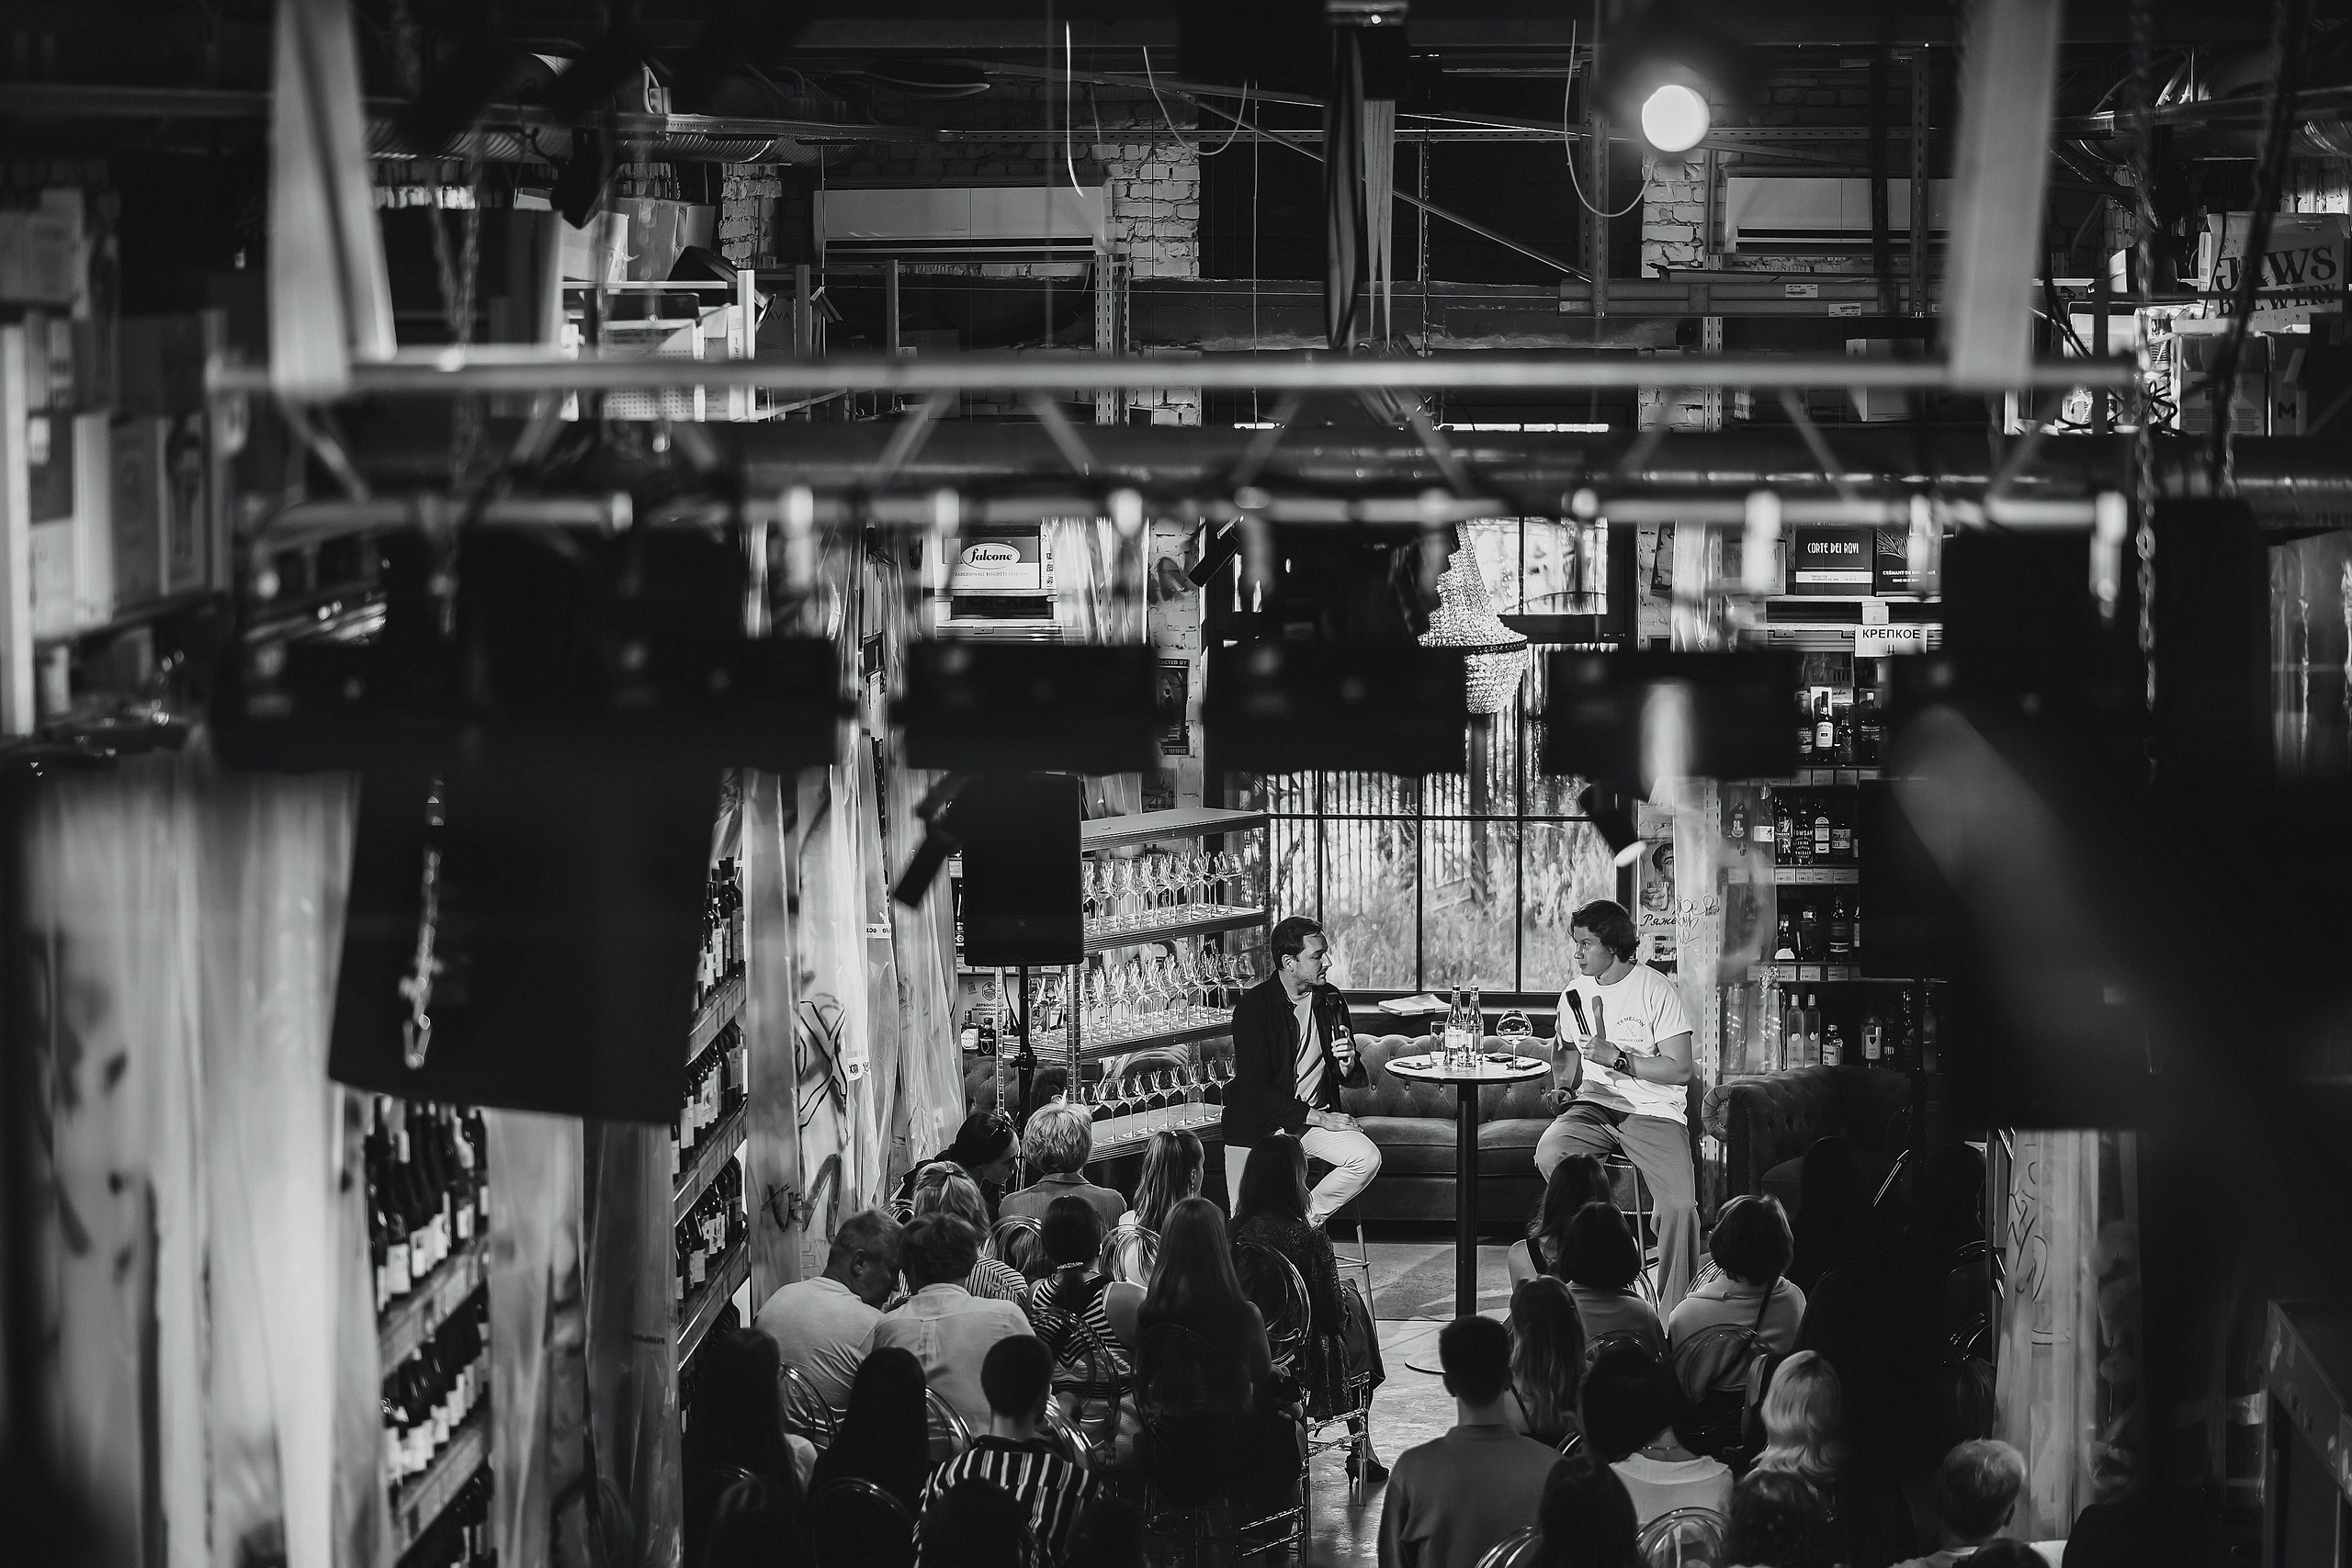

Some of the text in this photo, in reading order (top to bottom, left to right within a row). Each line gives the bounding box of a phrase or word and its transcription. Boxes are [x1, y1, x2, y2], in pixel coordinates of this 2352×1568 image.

[1806, 542, 1860, 555] CORTE DEI ROVI
[969, 547, 1012, 564] falcone
[1862, 628, 1920, 639] КРЕПКОЕ
